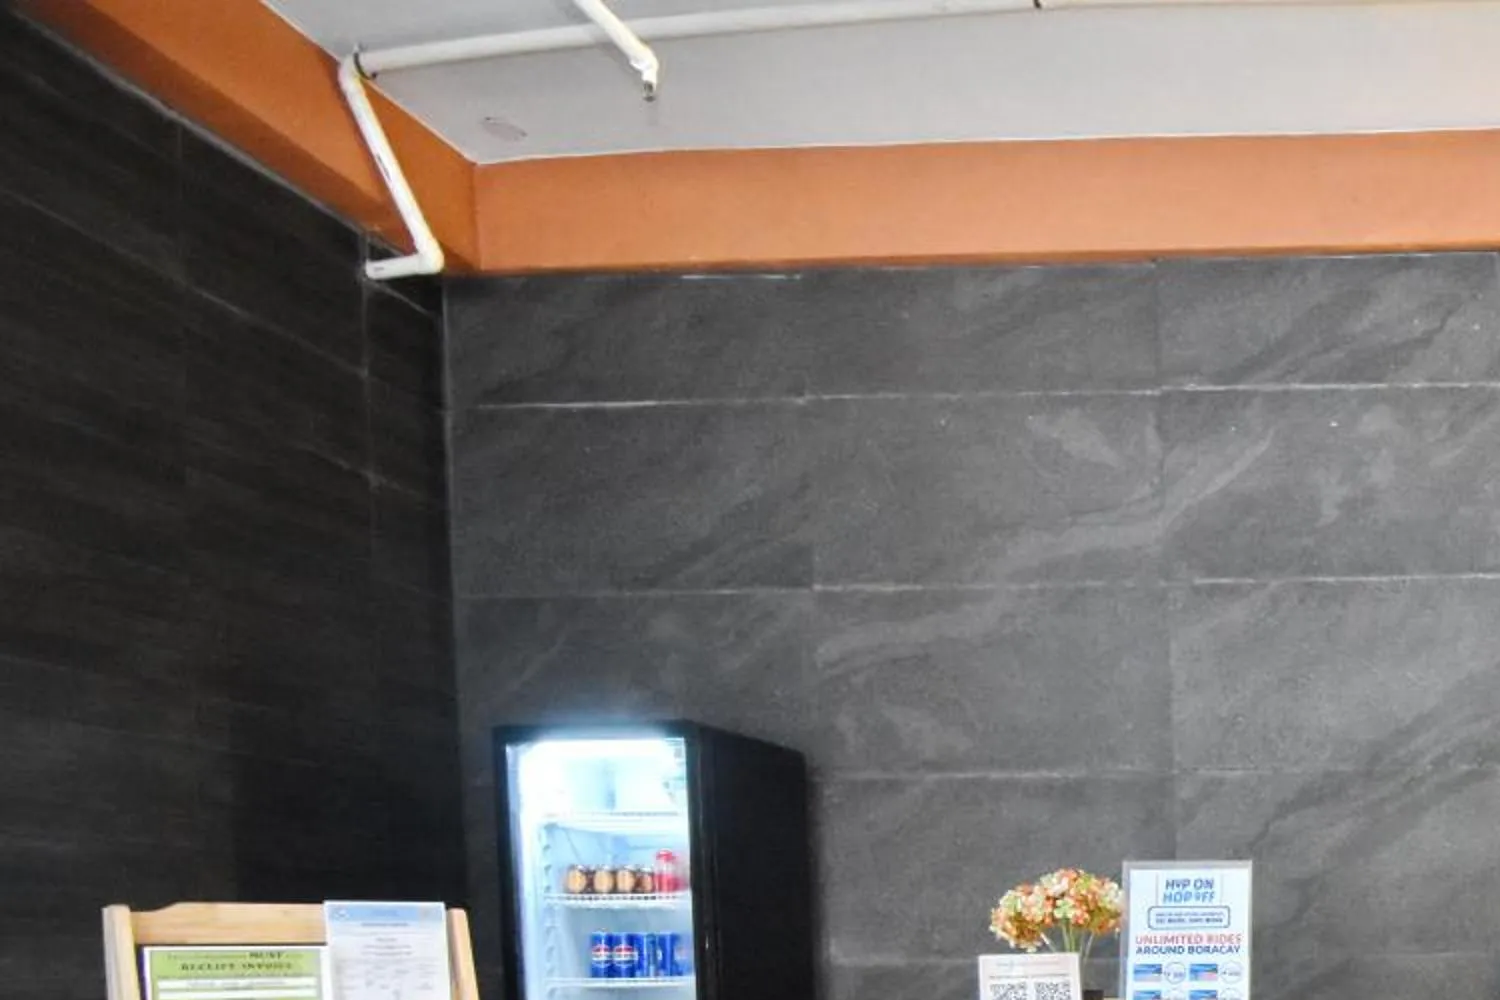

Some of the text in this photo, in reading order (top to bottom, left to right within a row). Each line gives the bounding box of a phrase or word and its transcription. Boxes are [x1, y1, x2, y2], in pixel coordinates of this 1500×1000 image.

[1193, 878, 1215, 891] ON
[1162, 891, 1193, 903] HOP
[1135, 933, 1242, 945] UNLIMITED RIDES
[1135, 945, 1241, 955] AROUND BORACAY
